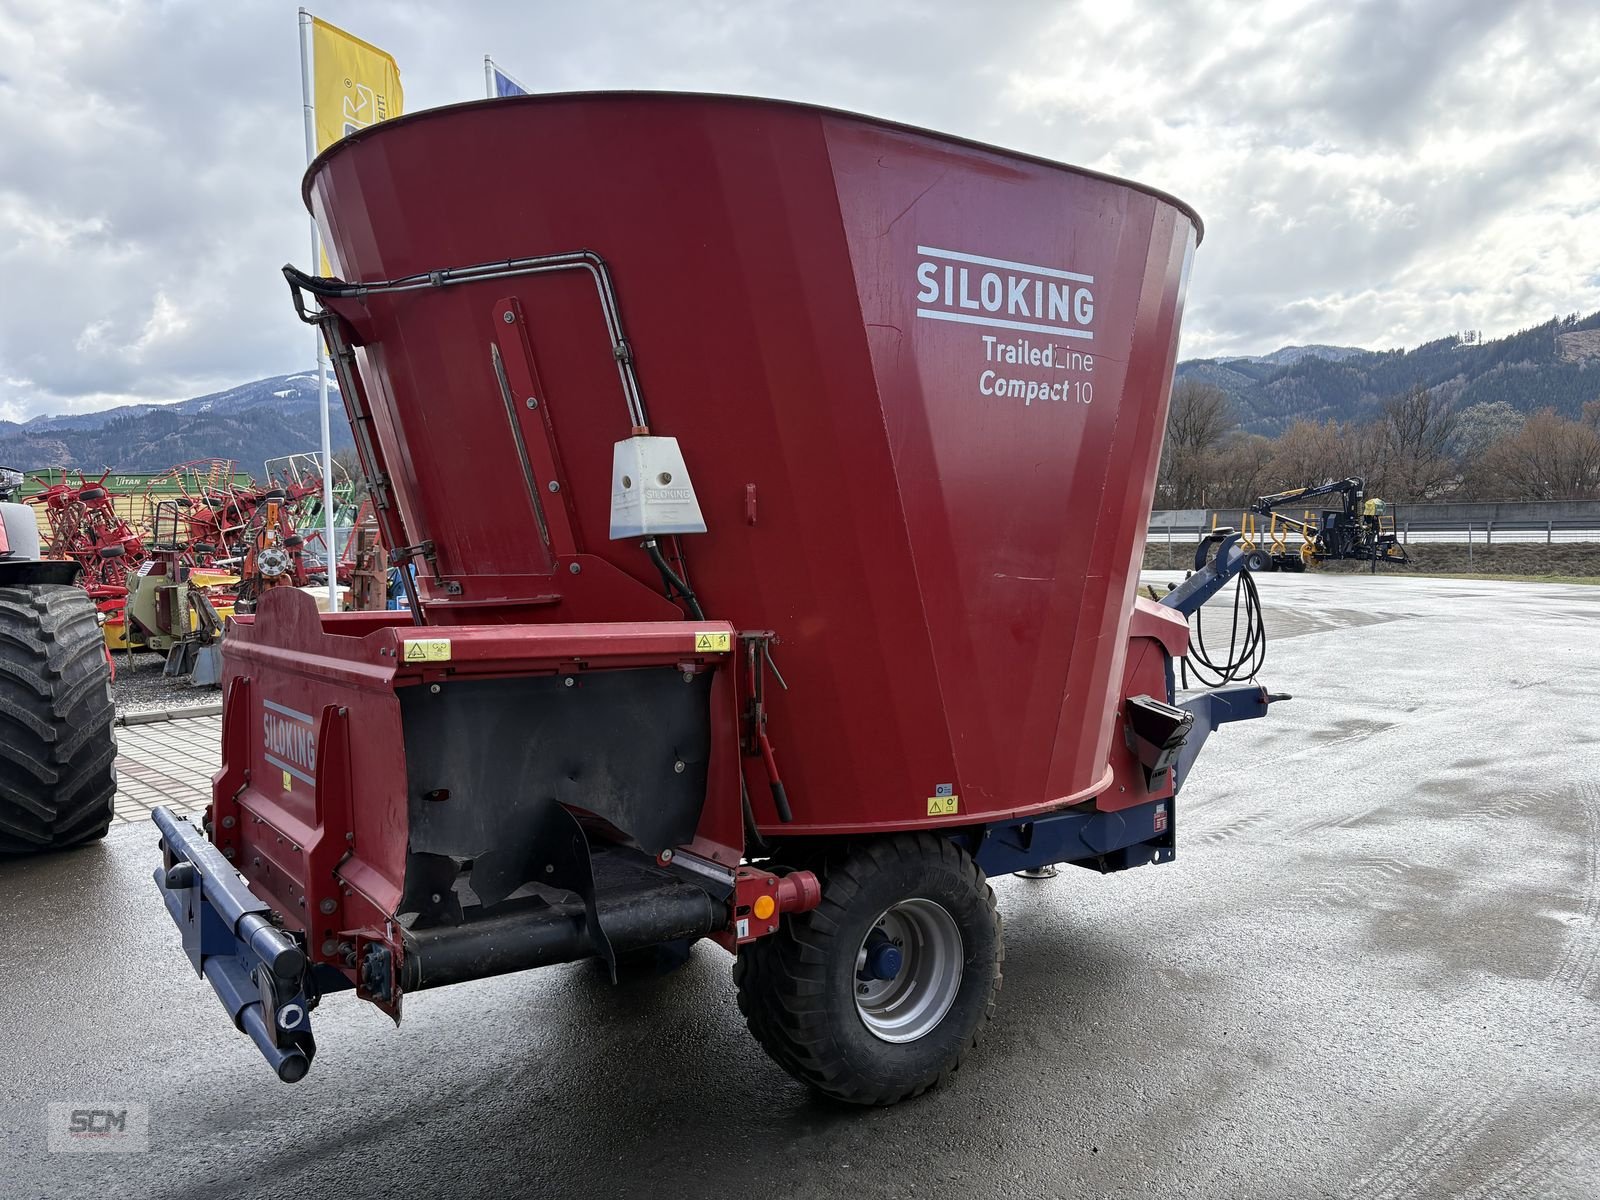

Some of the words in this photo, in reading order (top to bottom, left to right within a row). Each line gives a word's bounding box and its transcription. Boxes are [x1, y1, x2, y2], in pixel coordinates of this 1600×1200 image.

[916, 262, 1094, 325] SILOKING
[982, 335, 1094, 372] TrailedLine
[979, 369, 1069, 406] Compact
[1074, 381, 1093, 404] 10
[646, 489, 691, 499] SILOKING
[263, 712, 316, 772] SILOKING
